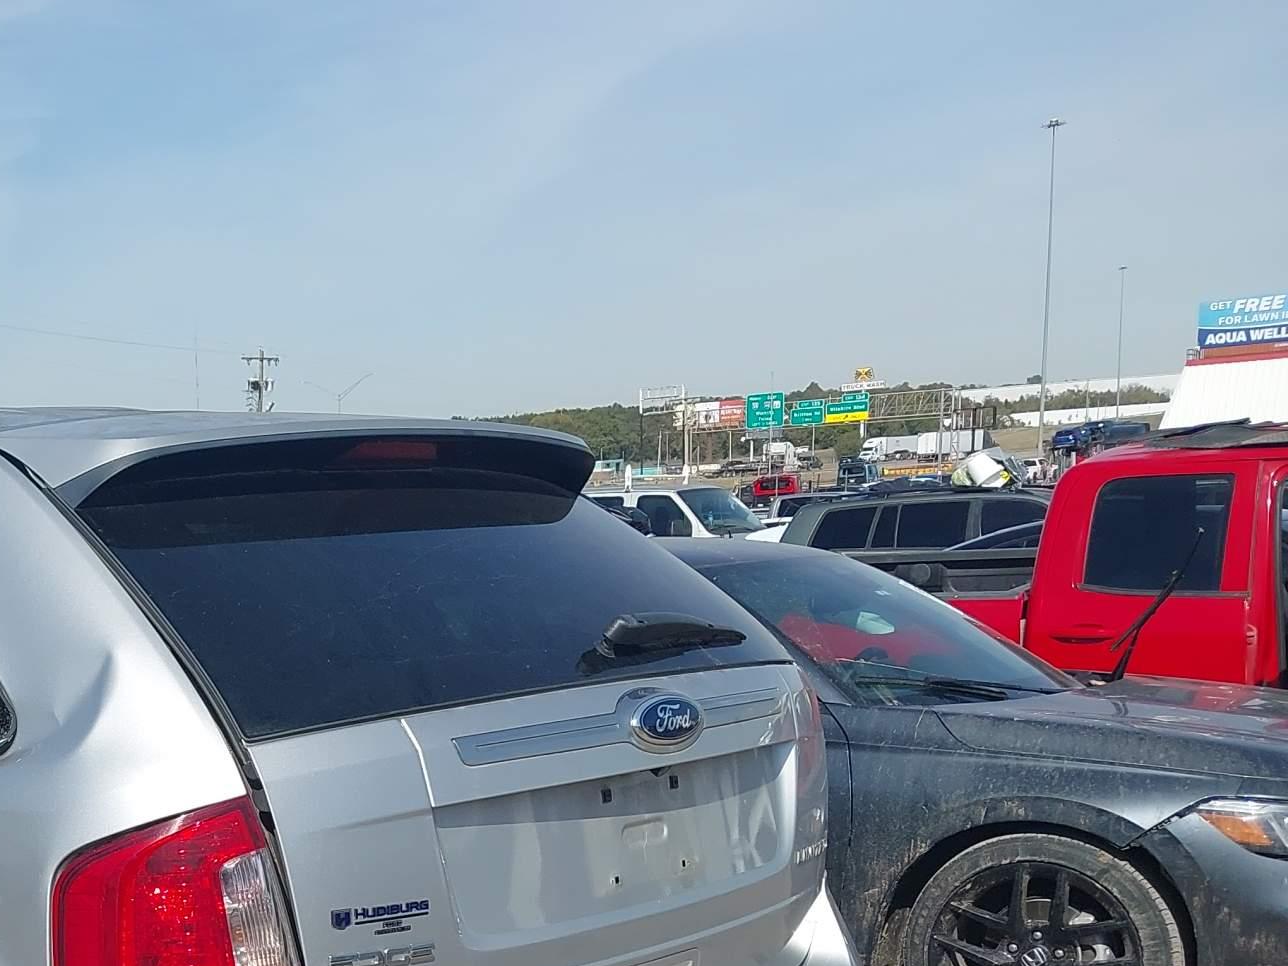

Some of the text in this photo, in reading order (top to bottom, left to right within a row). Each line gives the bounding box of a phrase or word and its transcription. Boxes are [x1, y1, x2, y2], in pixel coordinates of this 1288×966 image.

[1210, 295, 1287, 313] GET FREE
[1219, 316, 1242, 325] FOR
[1245, 312, 1279, 322] LAWN
[1205, 331, 1247, 345] AQUA
[656, 704, 692, 732] Ford
[354, 900, 429, 920] HUDIBURG
